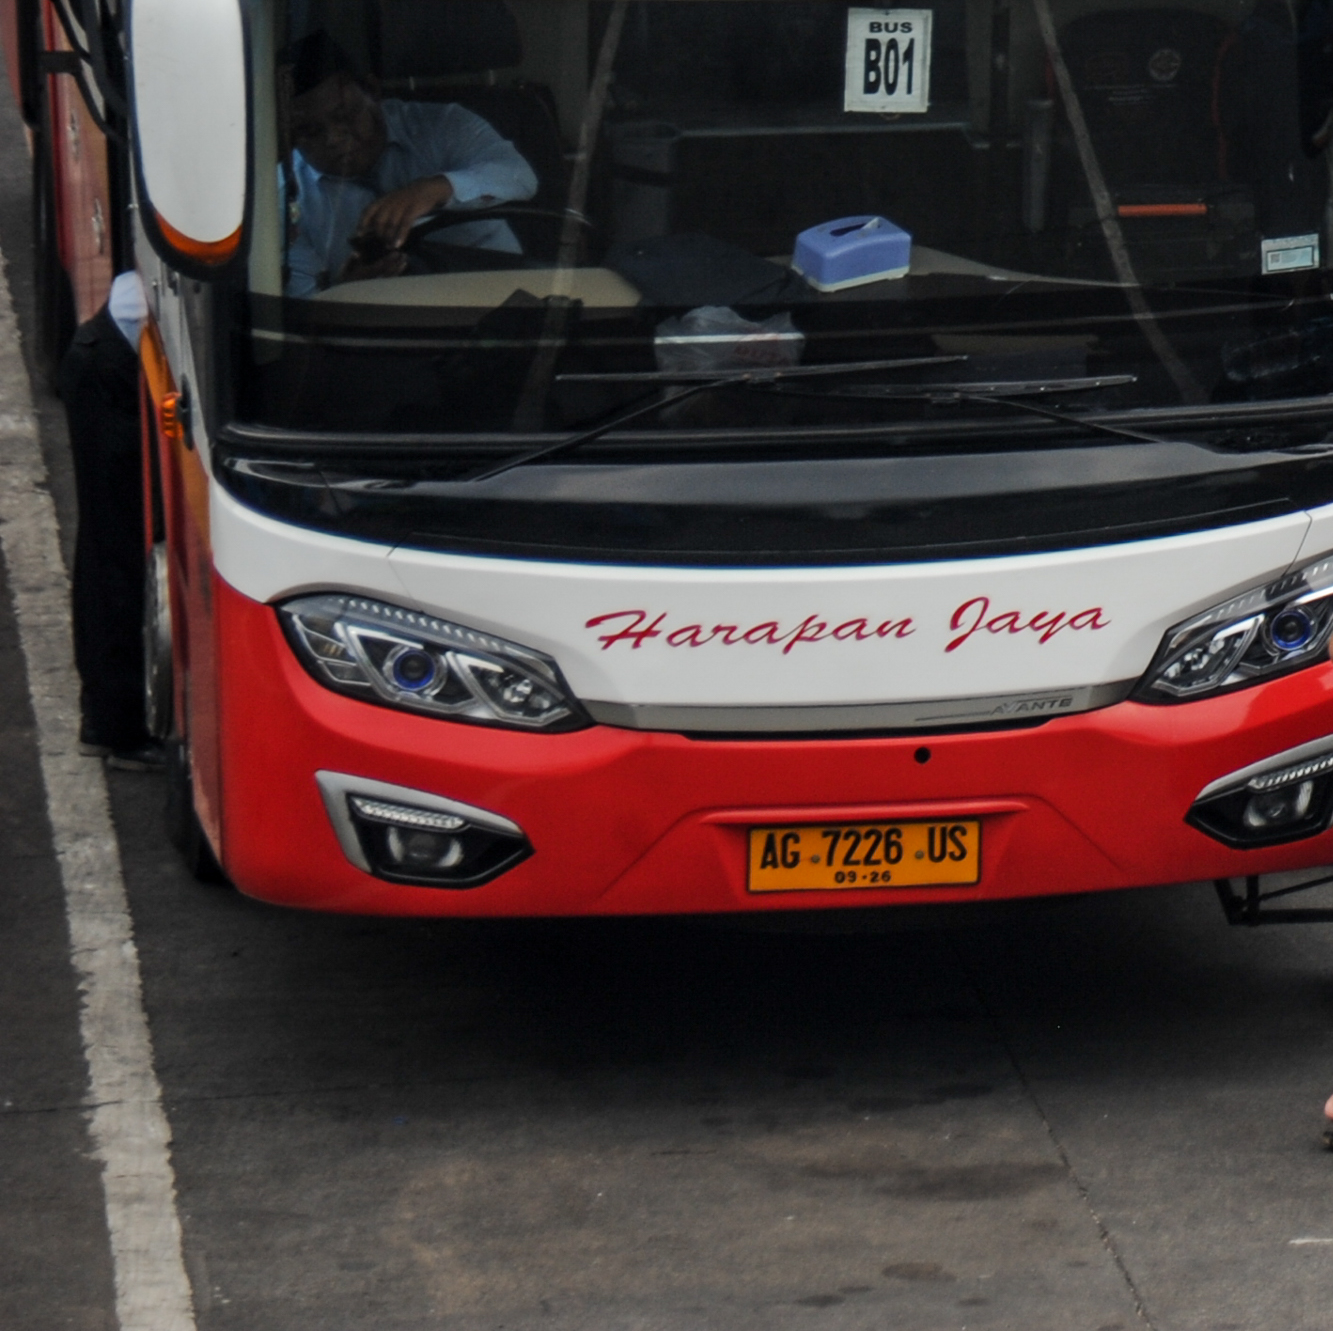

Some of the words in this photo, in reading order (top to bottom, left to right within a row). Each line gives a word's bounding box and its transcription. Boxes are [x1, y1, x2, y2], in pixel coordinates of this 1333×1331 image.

[869, 21, 913, 34] BUS
[584, 609, 917, 655] Harapan
[944, 595, 1112, 652] Jaya
[760, 831, 801, 869] AG
[821, 827, 904, 867] 7226
[927, 824, 968, 863] US
